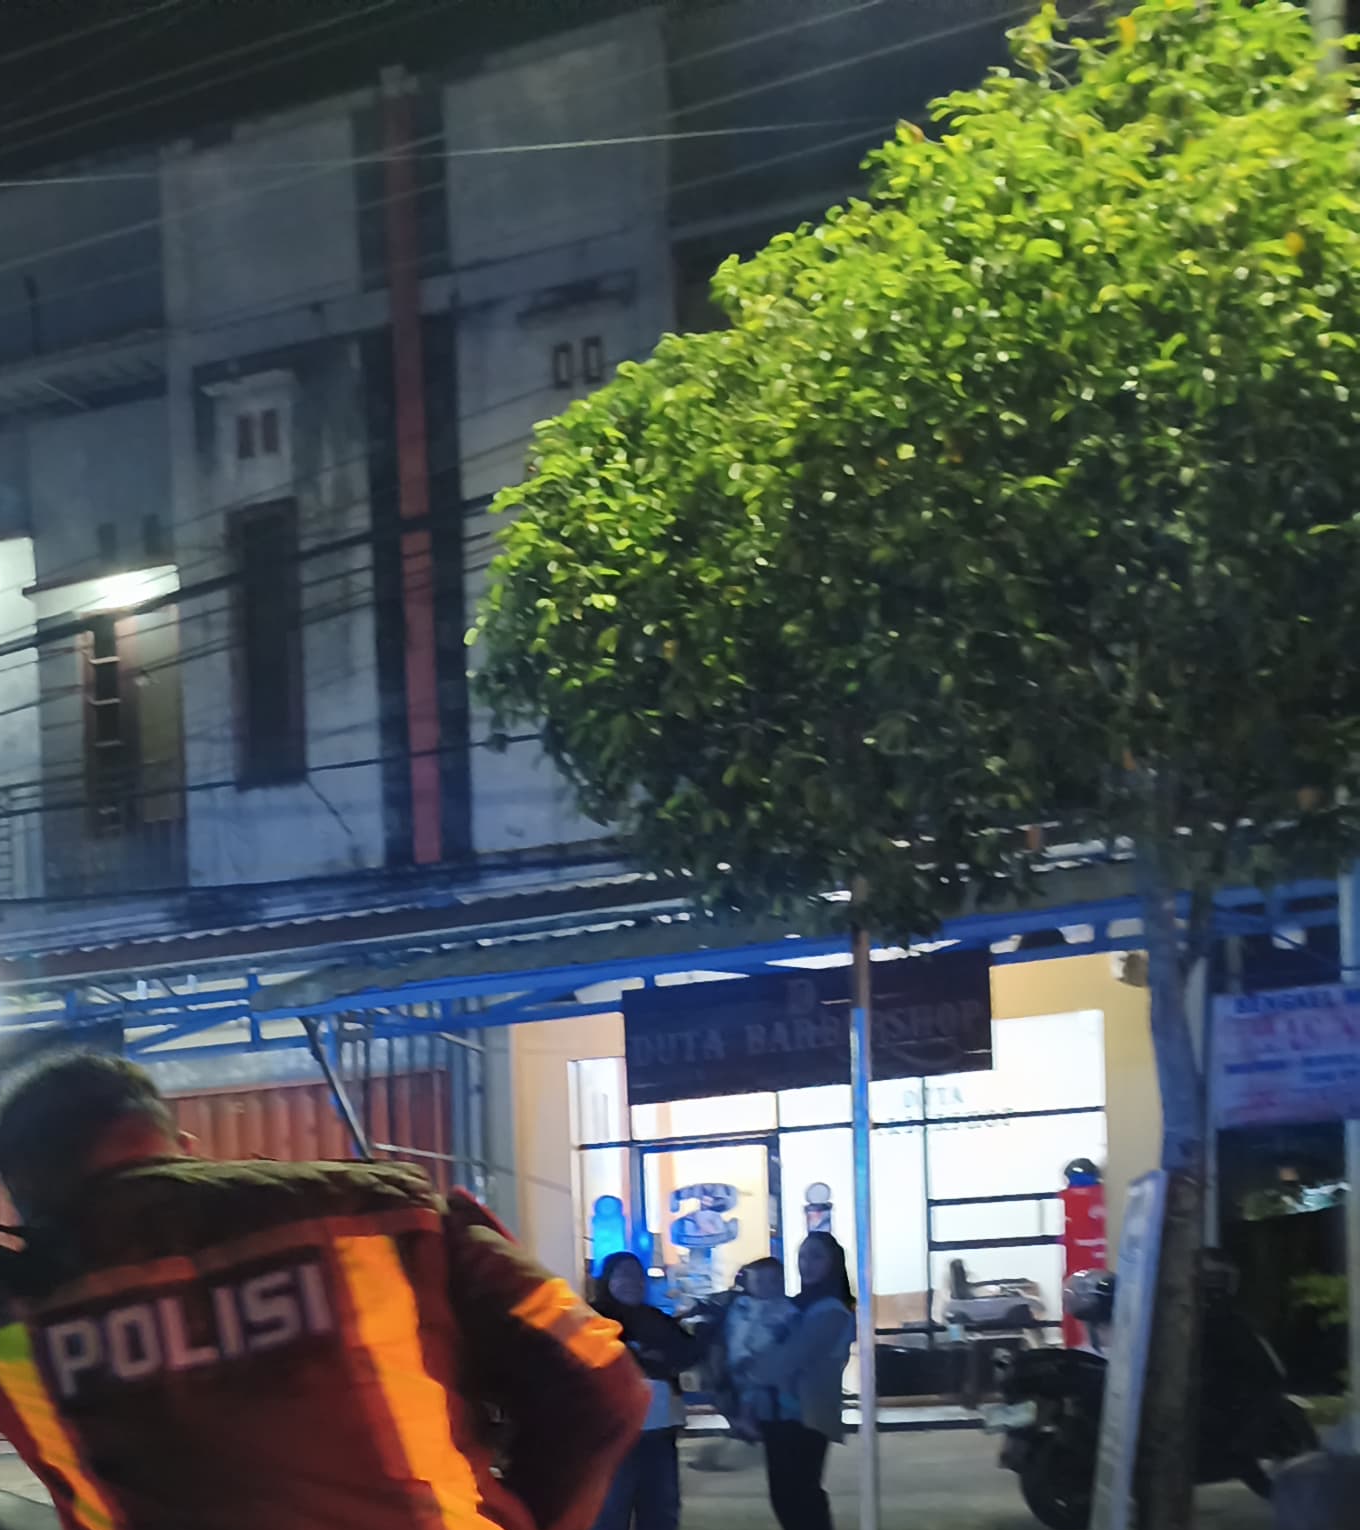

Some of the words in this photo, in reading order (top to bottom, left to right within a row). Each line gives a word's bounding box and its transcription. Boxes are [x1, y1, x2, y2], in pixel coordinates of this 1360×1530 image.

[630, 1027, 727, 1067] DUTA
[744, 998, 984, 1056] BARBRSHOP
[46, 1263, 333, 1398] POLISI
